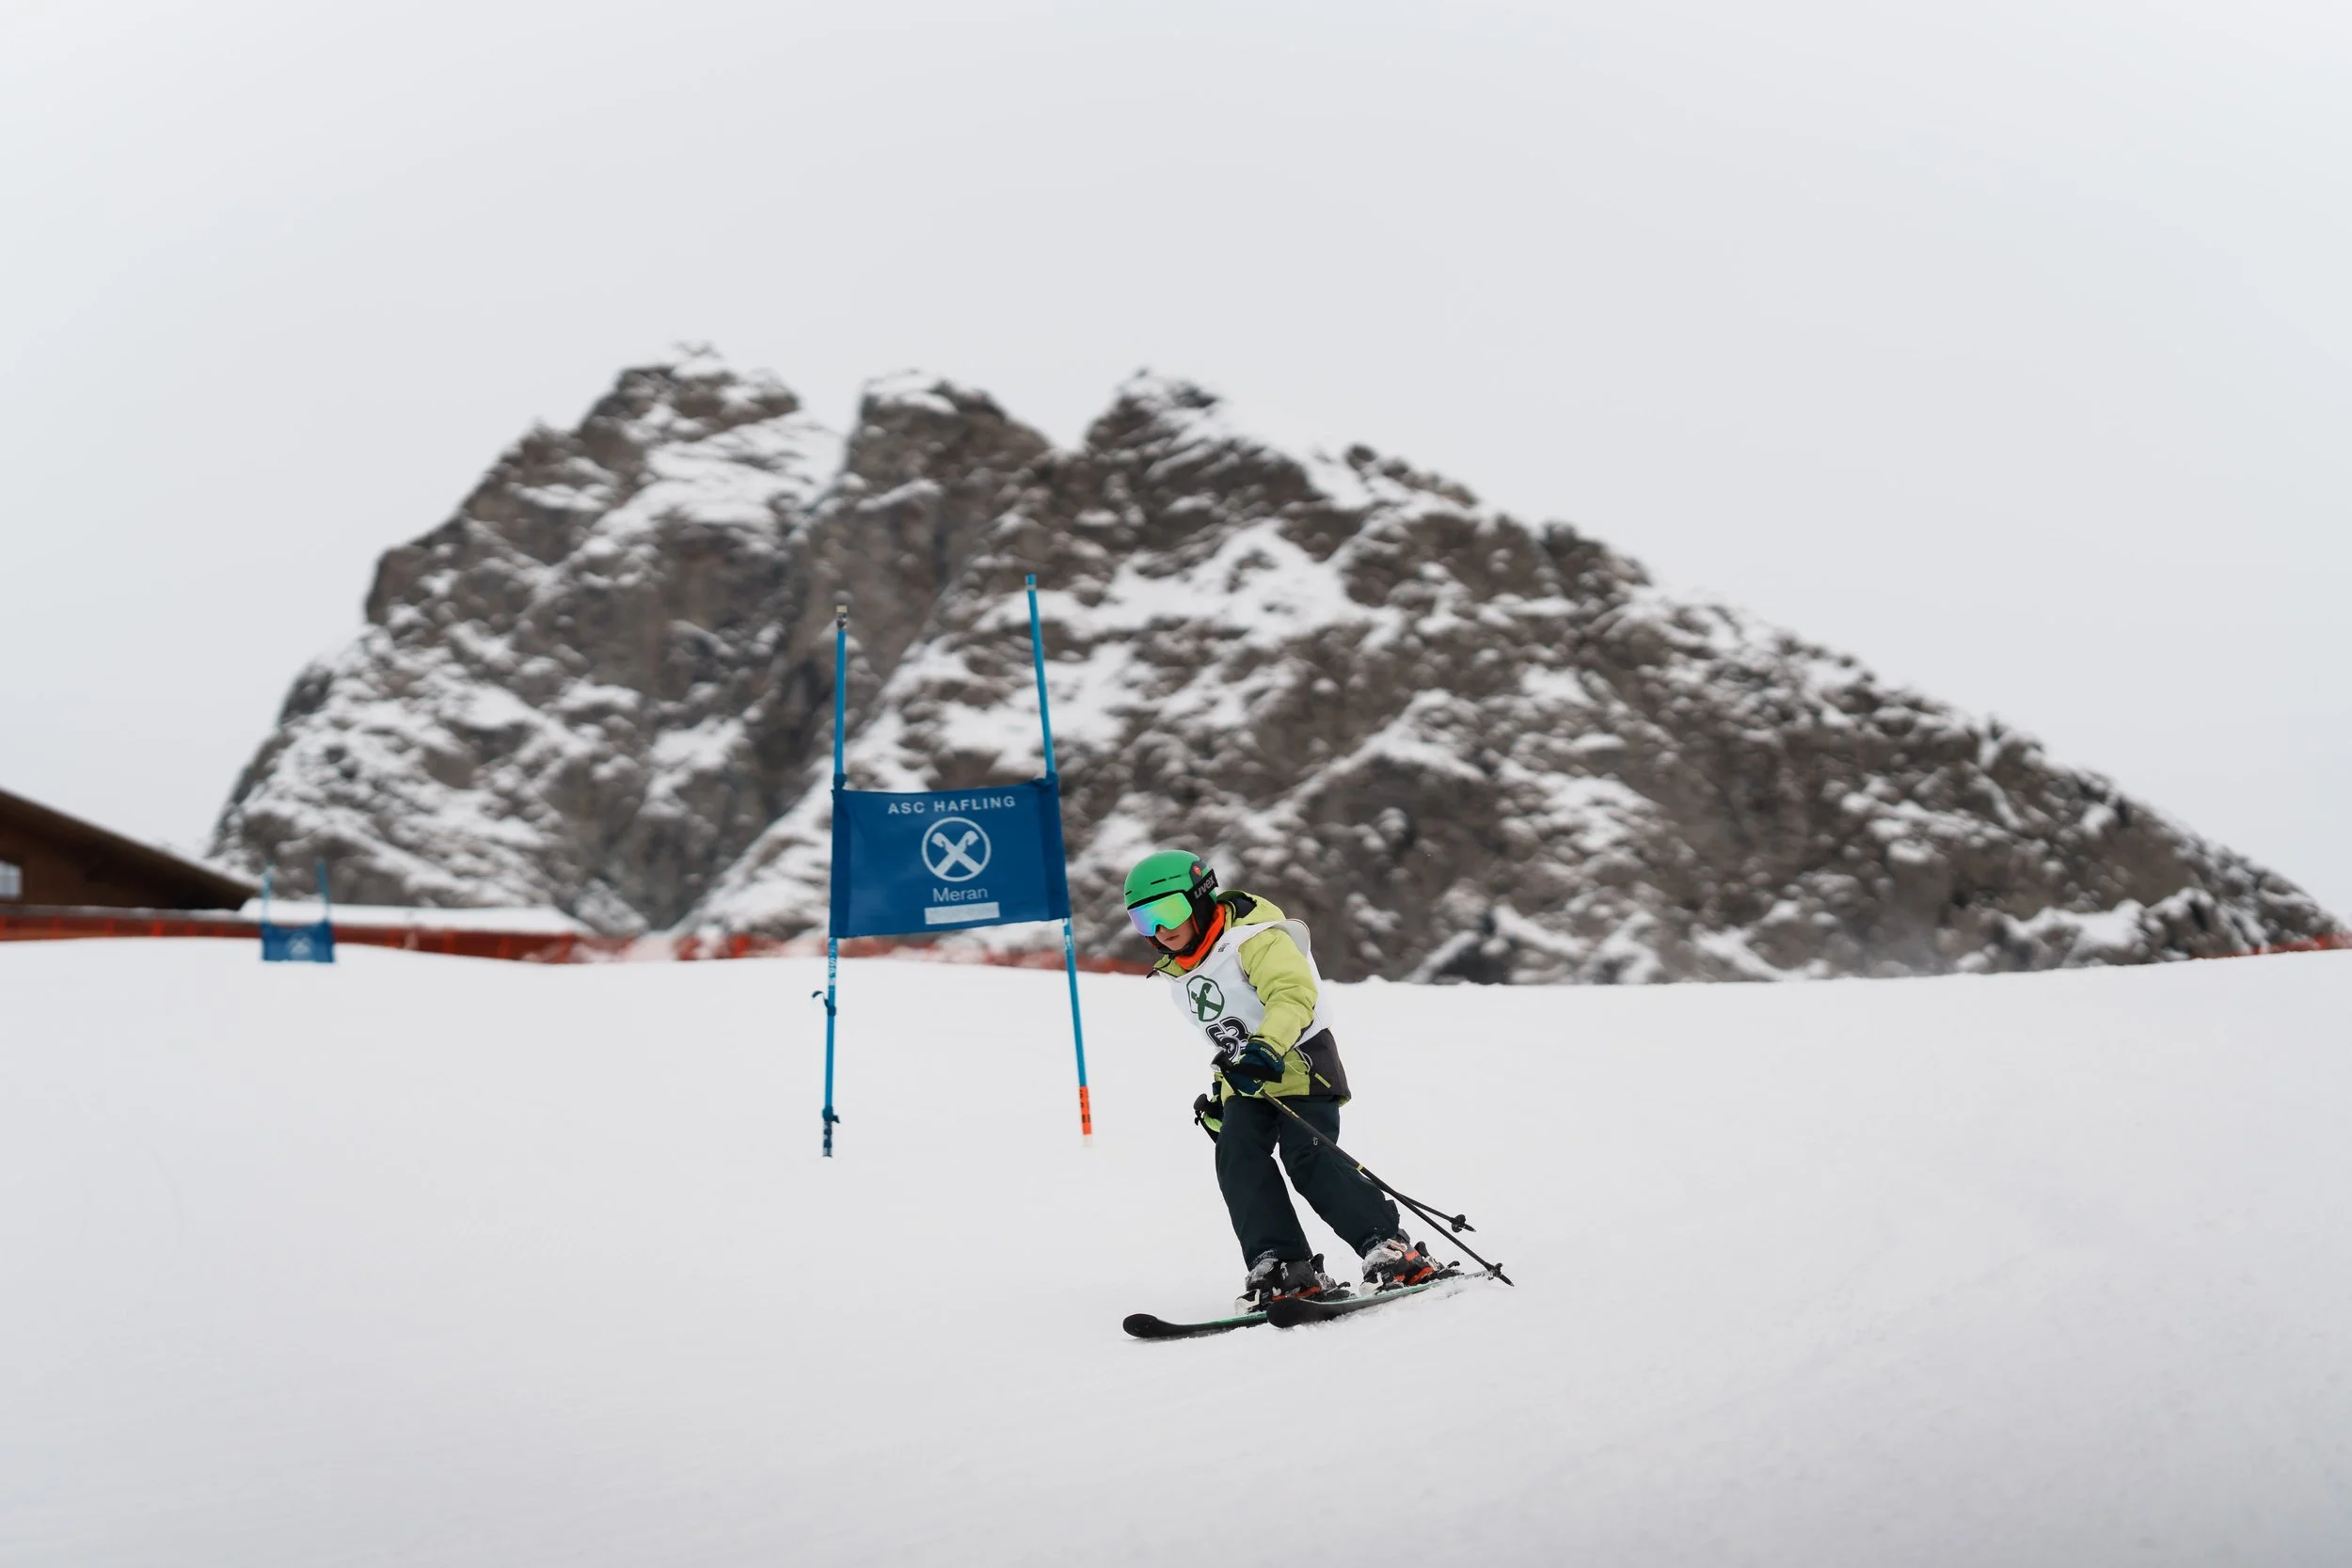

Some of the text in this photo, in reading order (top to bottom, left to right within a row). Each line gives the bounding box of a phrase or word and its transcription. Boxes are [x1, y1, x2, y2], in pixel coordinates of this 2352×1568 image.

[887, 796, 1016, 815] ASC HAFLING
[932, 887, 989, 902] Meran
[1194, 876, 1216, 899] uvex
[1205, 1016, 1250, 1063] 53
